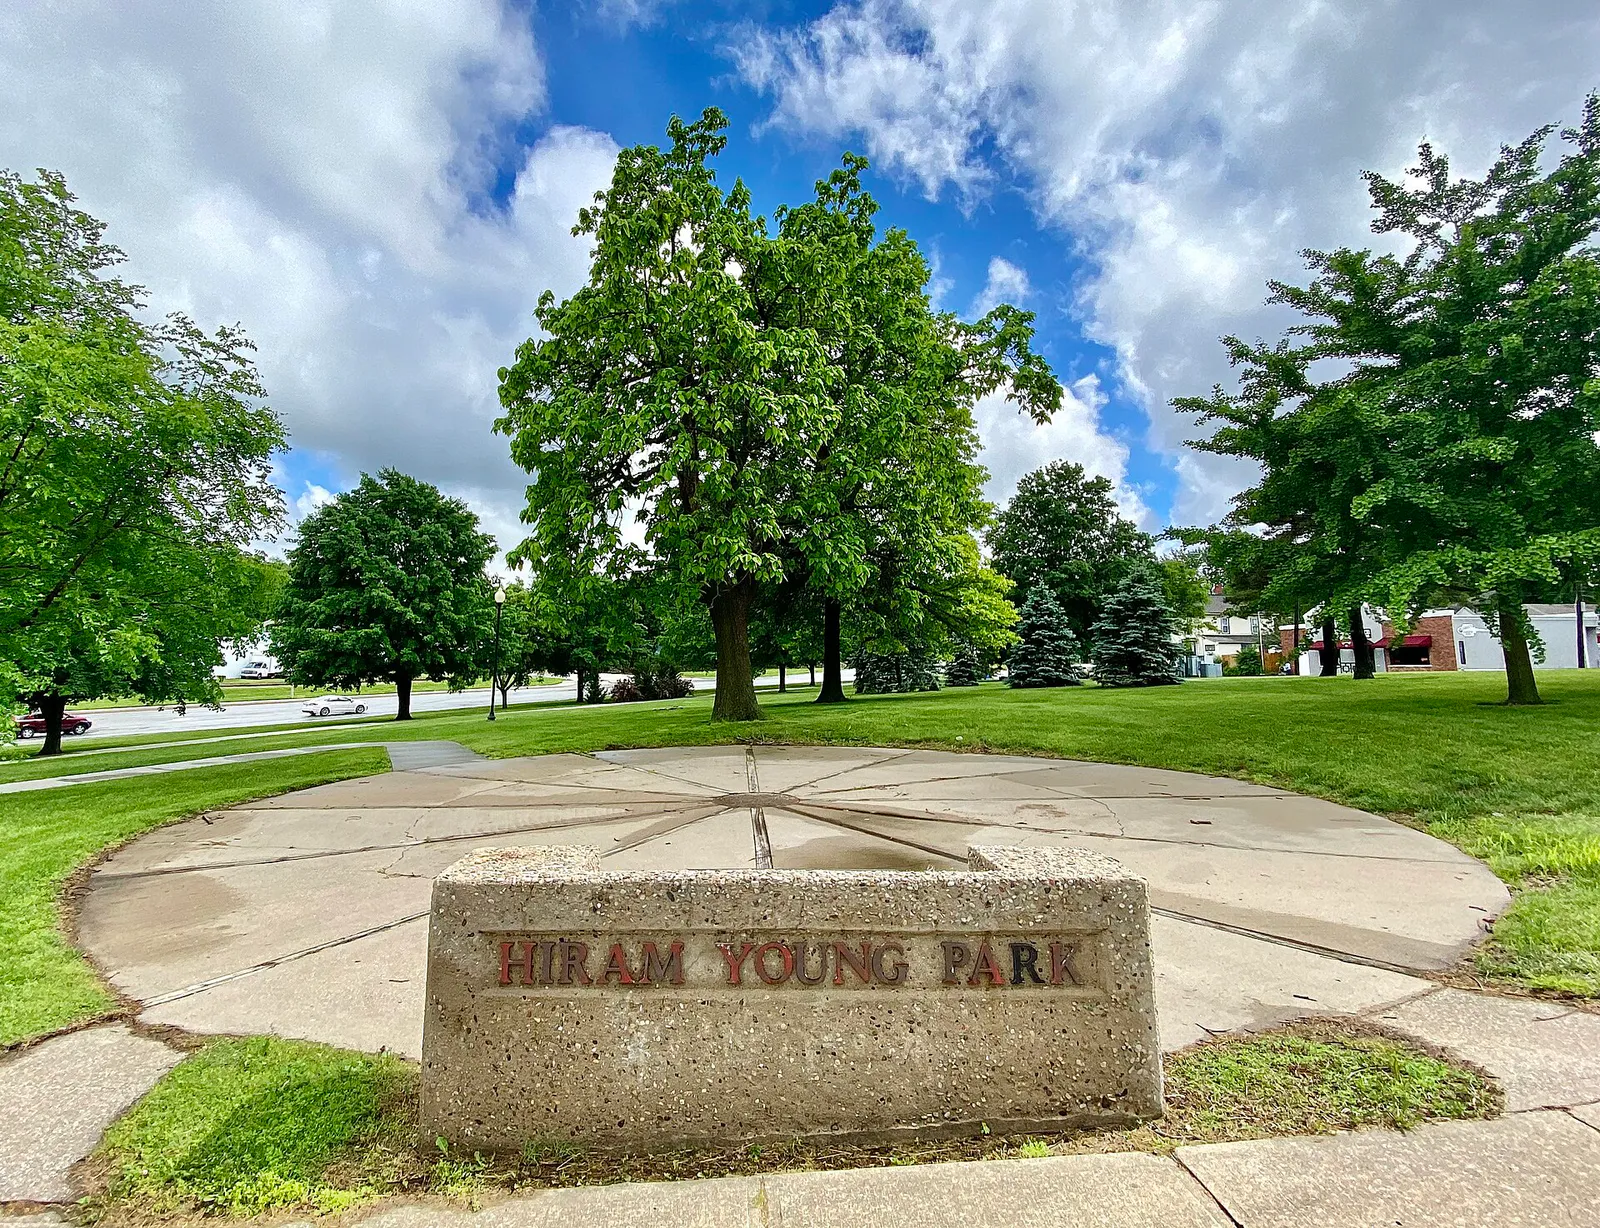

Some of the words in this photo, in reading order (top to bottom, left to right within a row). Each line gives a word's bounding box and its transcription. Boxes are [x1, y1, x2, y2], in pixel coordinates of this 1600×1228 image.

[499, 940, 686, 986] HIRAM
[715, 940, 909, 986] YOUNG
[941, 940, 1084, 986] PARK
